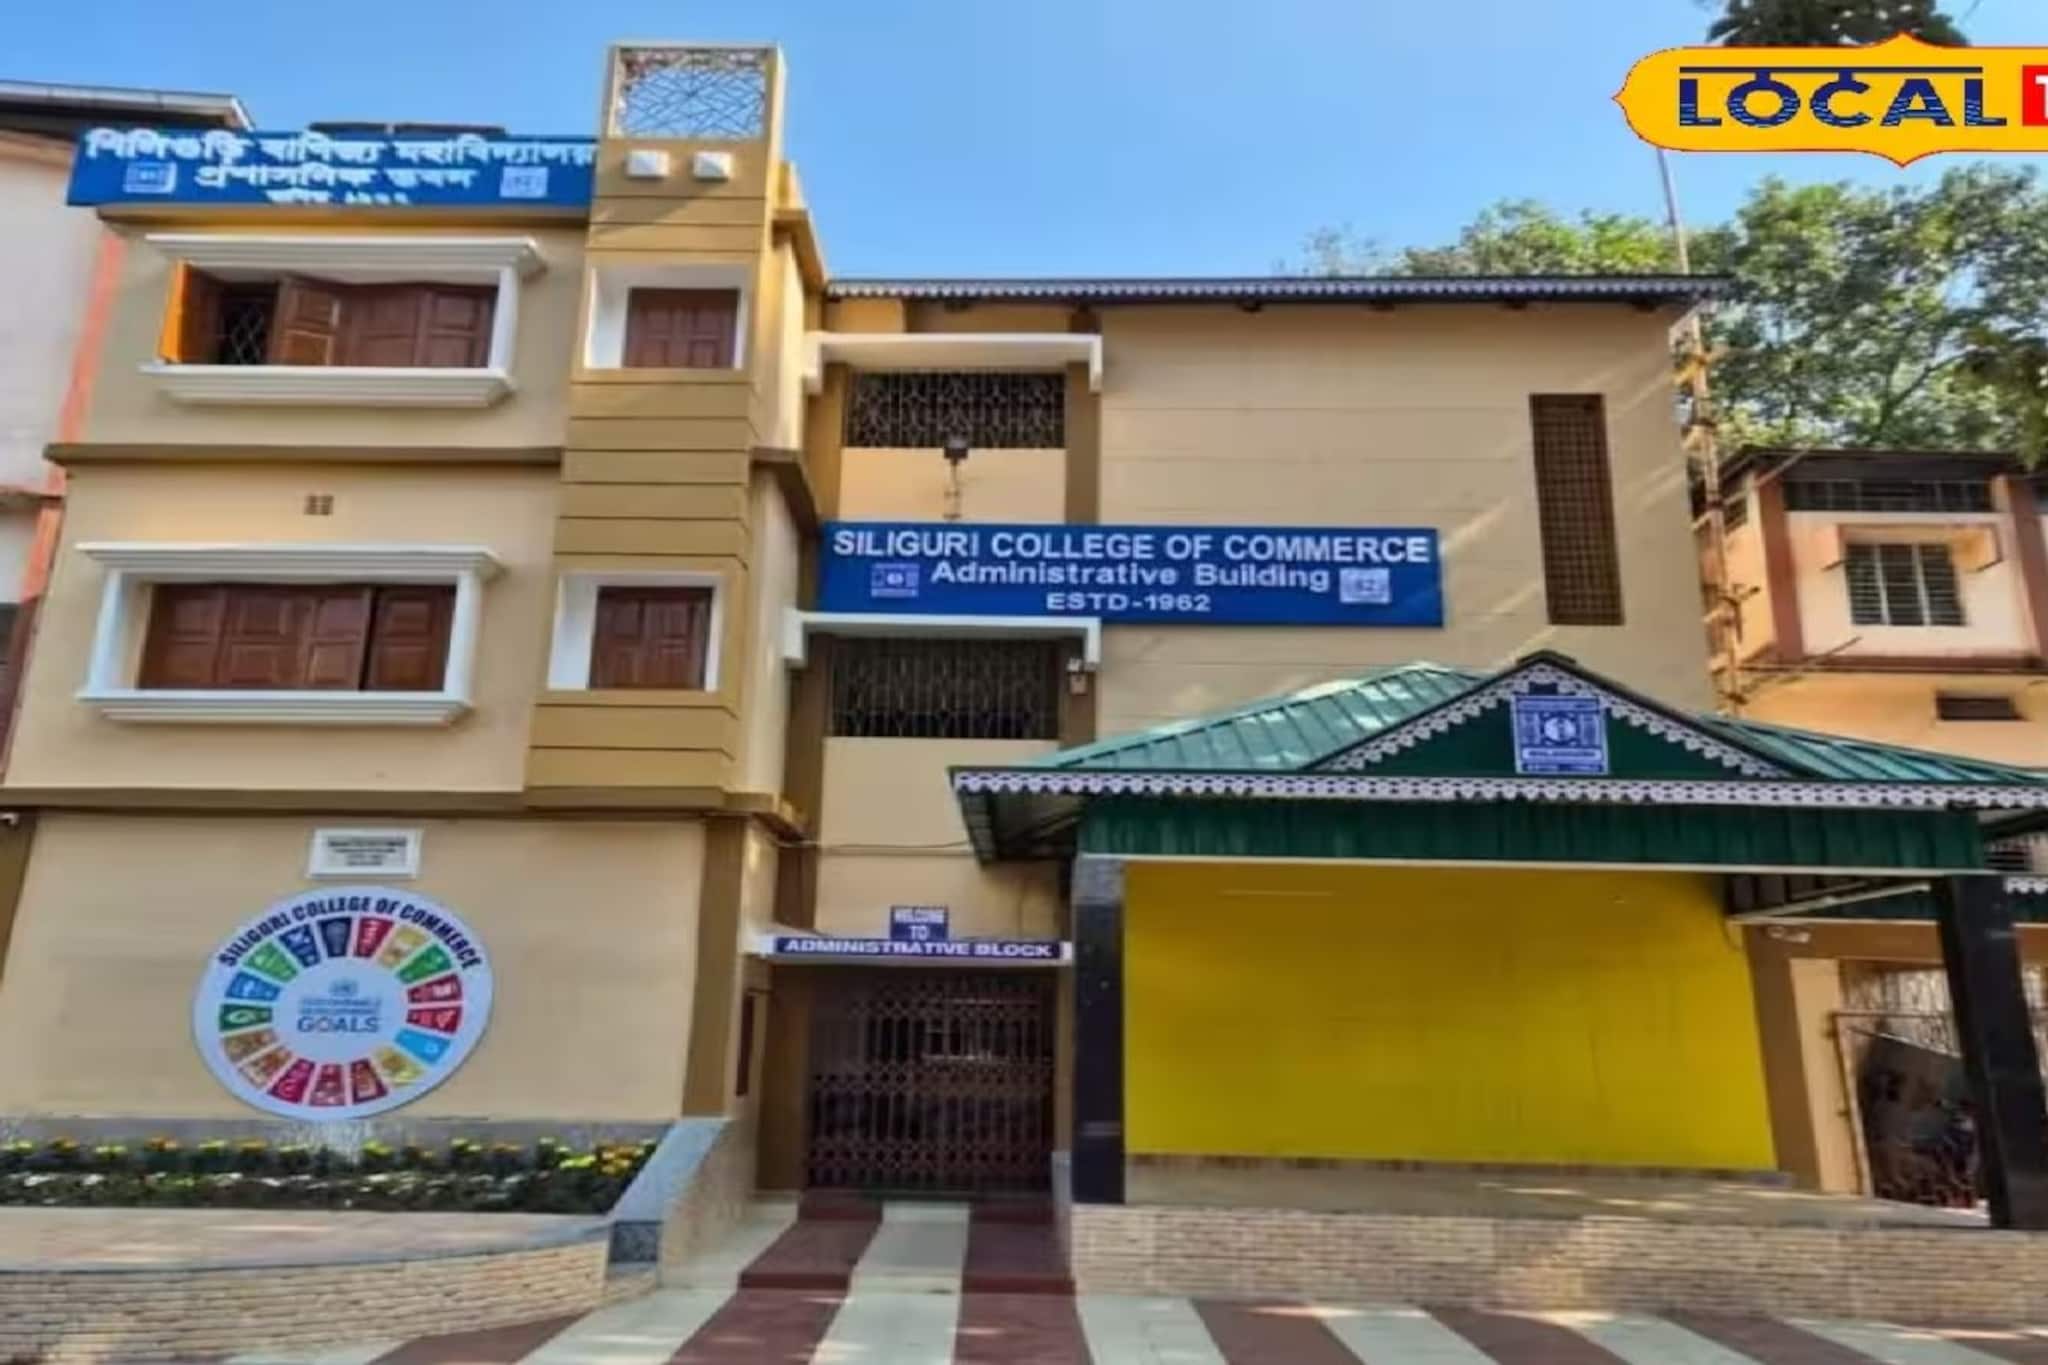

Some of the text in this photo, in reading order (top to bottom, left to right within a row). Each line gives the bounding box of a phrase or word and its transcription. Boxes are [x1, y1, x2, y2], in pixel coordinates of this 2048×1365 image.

[833, 530, 1430, 562] SILIGURI COLLEGE OF COMMERCE
[931, 560, 1330, 592] Administrative Building
[1046, 592, 1211, 612] ESTD-1962
[218, 896, 482, 969] SILIGURI COLLEGE OF COMMERCE
[909, 925, 930, 941] TO
[785, 938, 1052, 957] ADMINISTRATIVE BLOCK
[297, 1015, 379, 1033] GOALS
